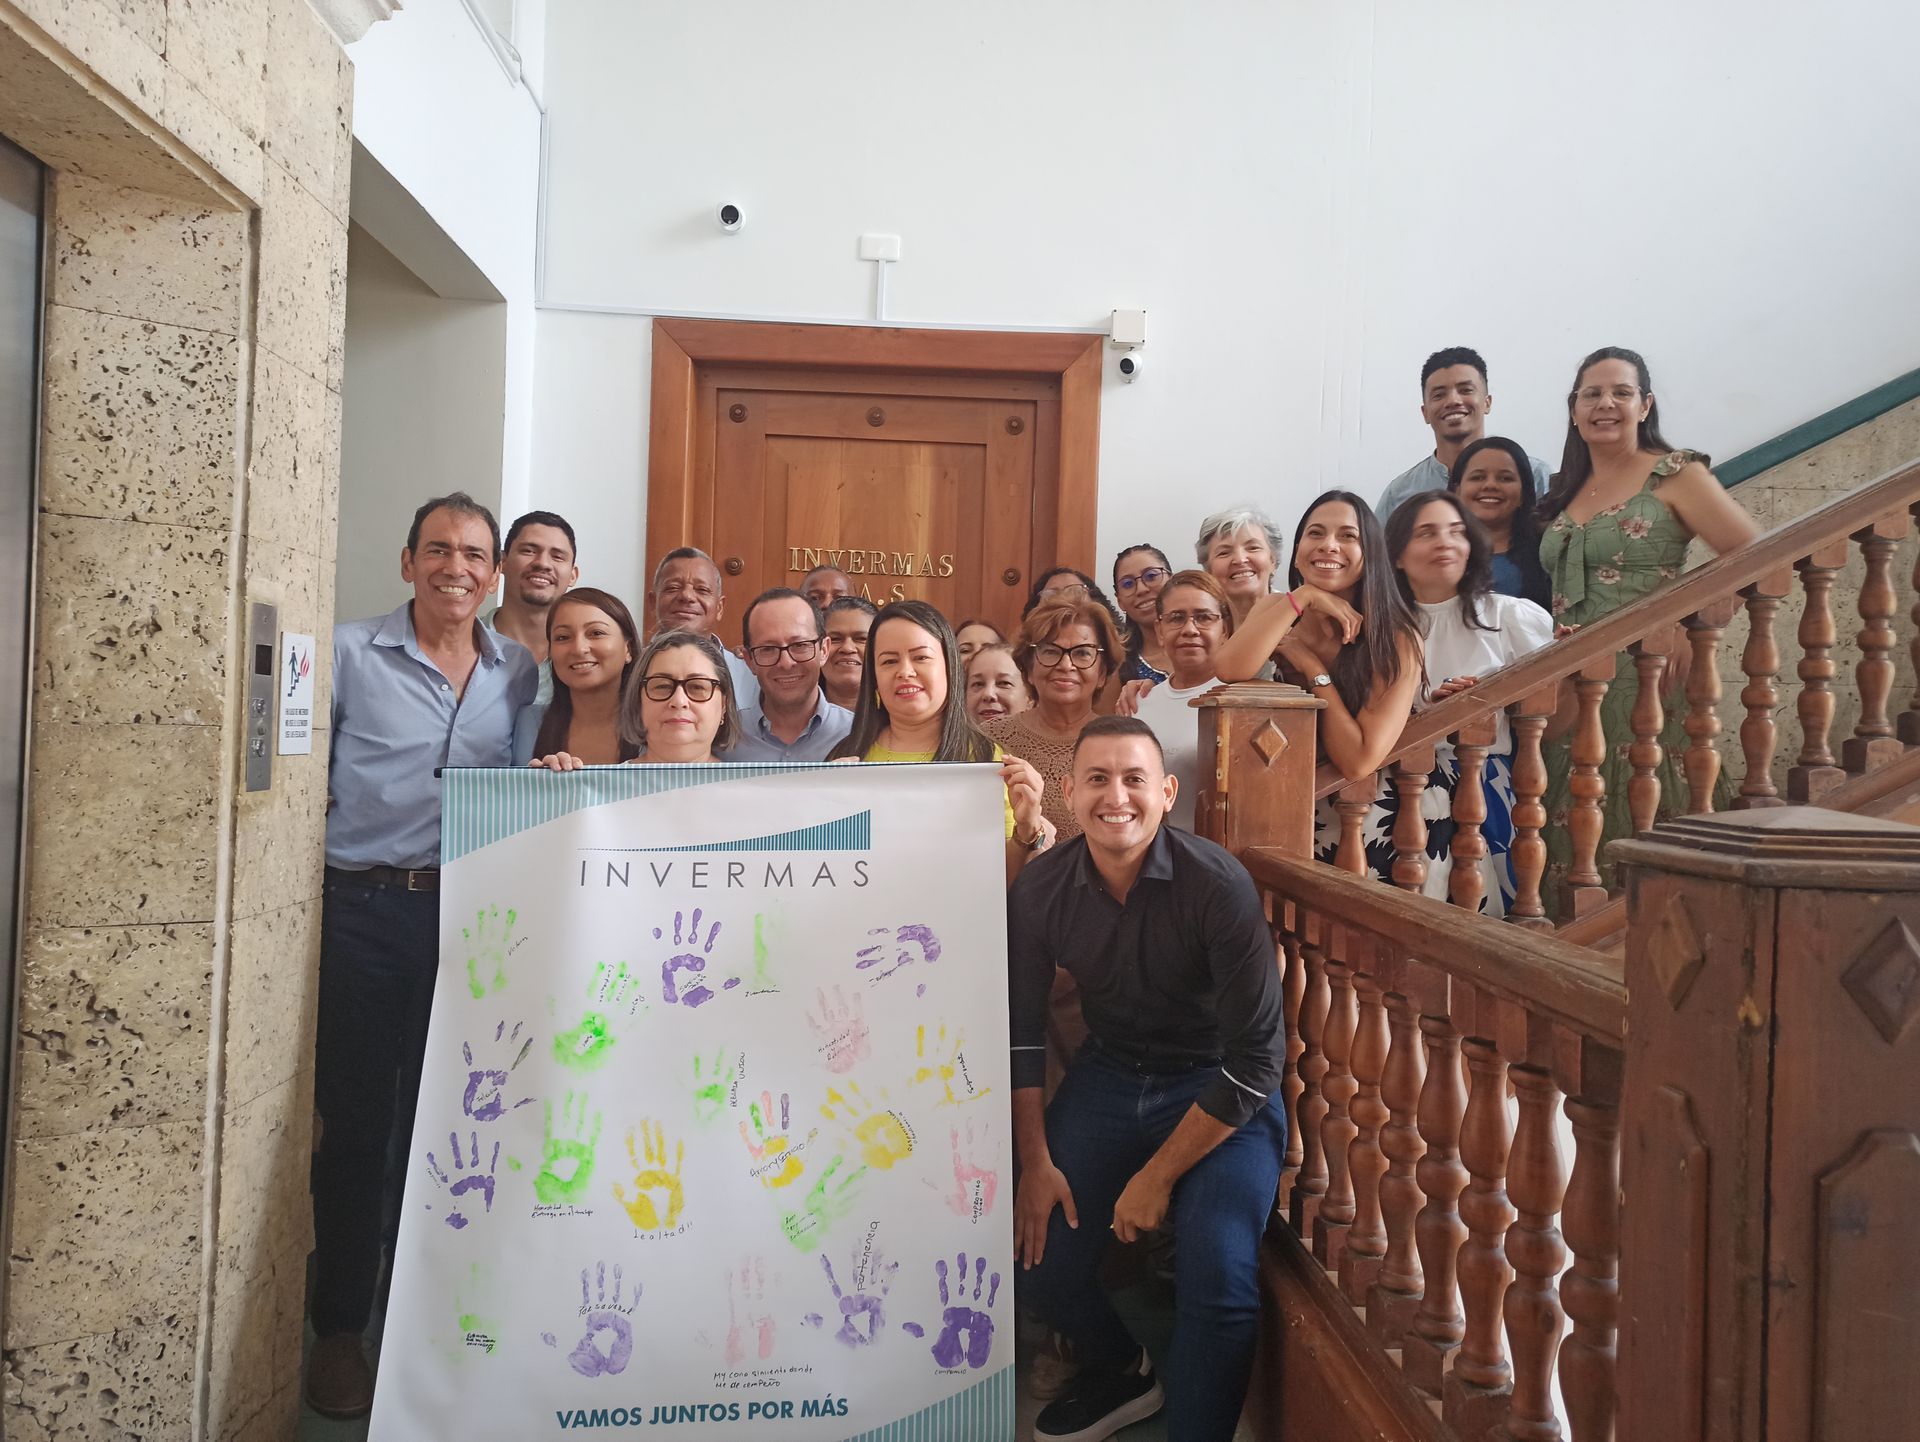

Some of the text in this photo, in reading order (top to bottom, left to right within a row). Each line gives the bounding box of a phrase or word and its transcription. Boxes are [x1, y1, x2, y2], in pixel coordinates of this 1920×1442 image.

[788, 547, 954, 578] INVERMAS
[580, 860, 869, 888] INVERMAS
[556, 1393, 849, 1429] VAMOS JUNTOS POR MÁS
